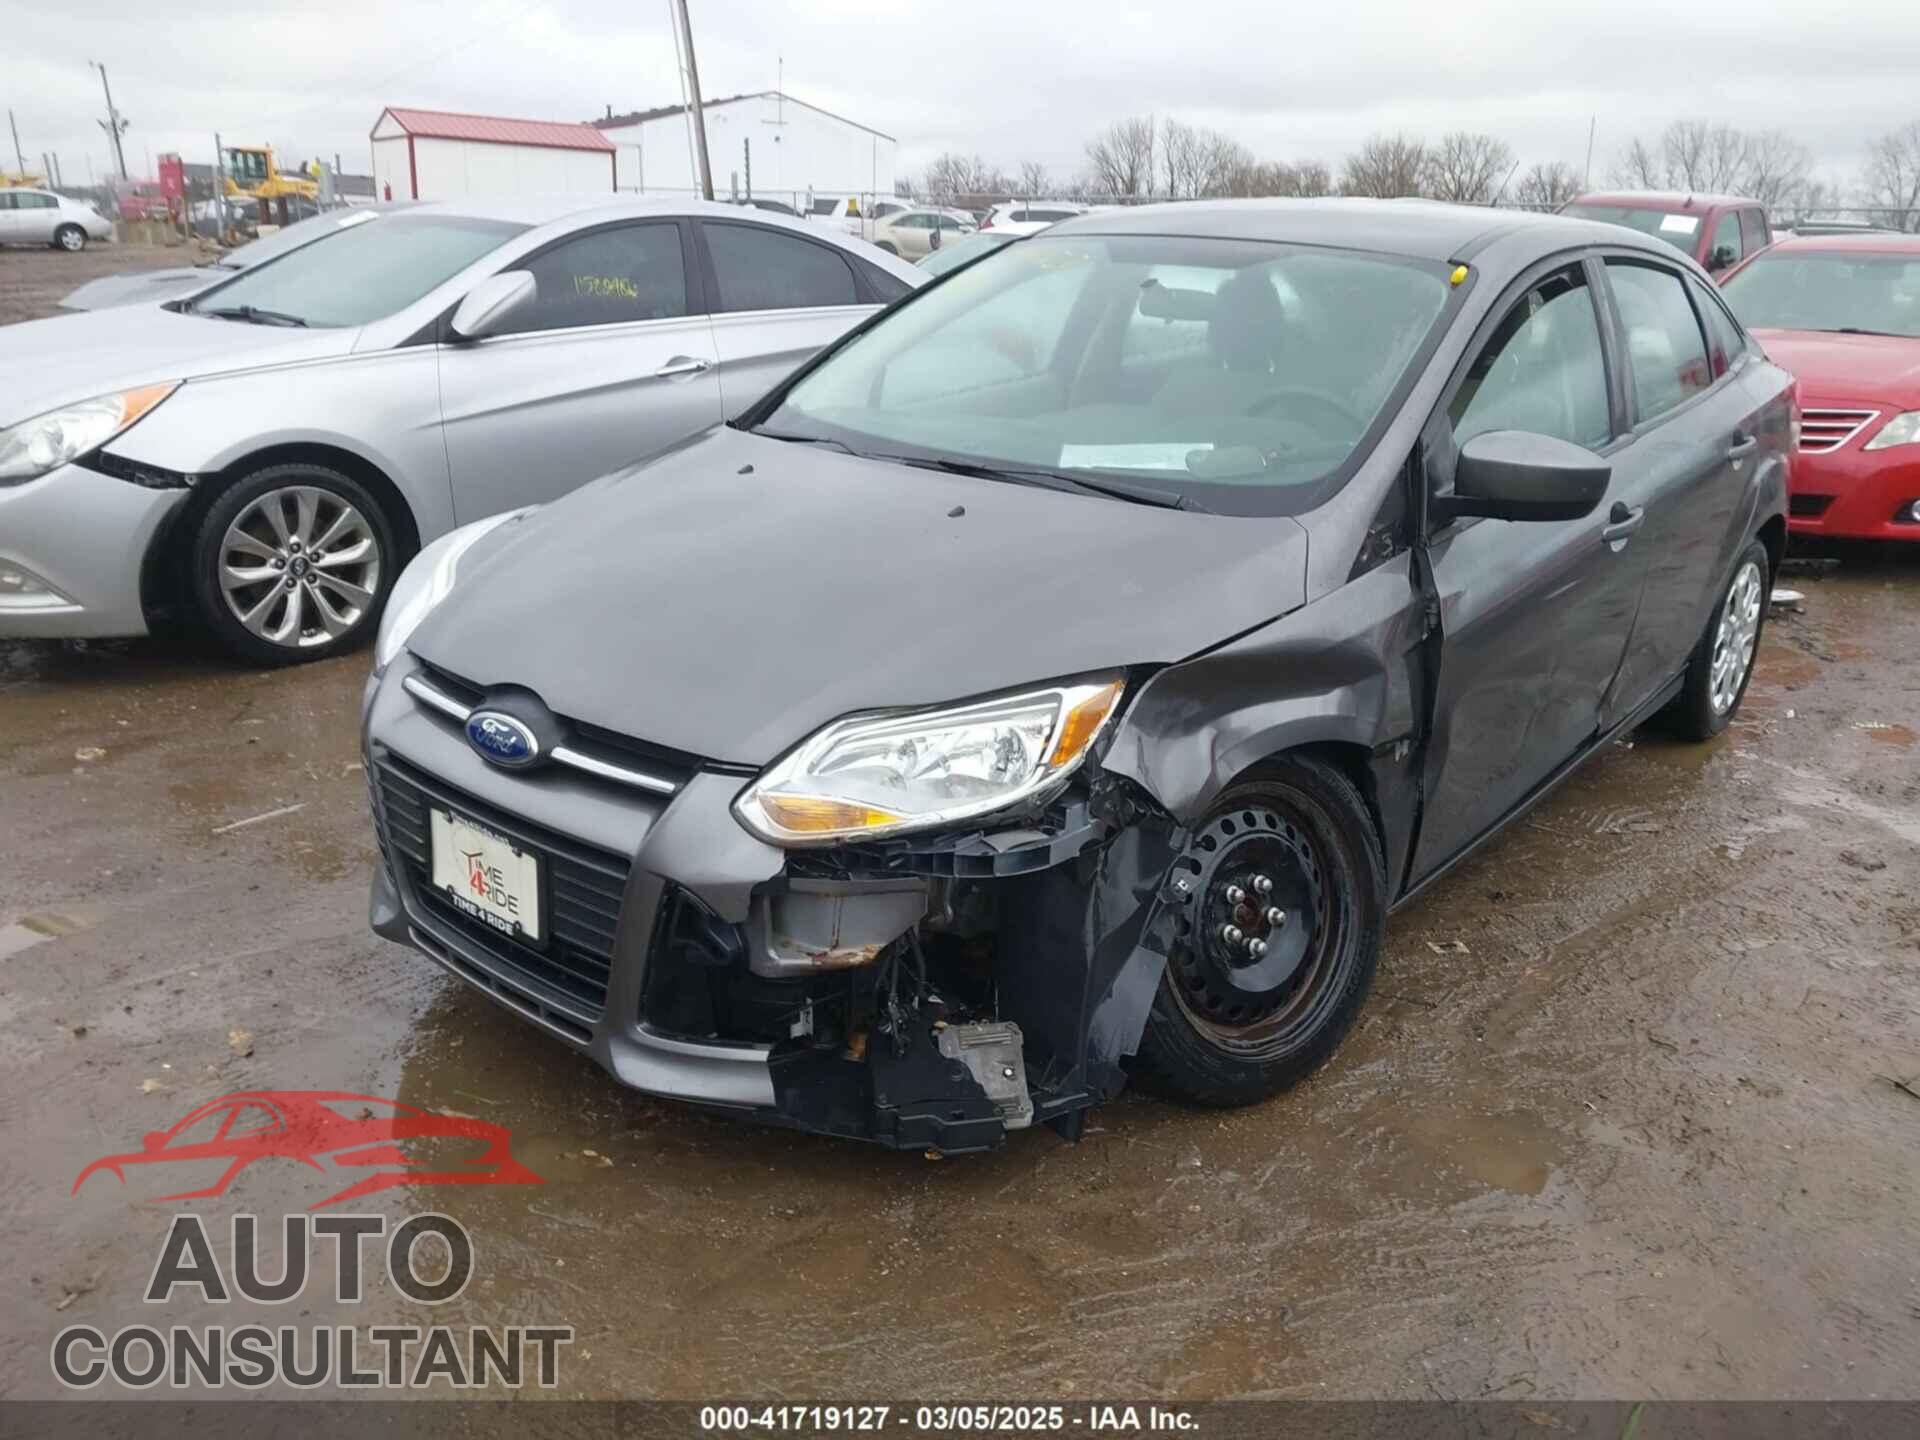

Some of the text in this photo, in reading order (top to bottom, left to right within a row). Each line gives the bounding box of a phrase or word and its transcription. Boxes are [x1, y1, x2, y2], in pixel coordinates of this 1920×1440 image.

[476, 718, 517, 753] Ford
[460, 850, 504, 889] TIME
[470, 870, 486, 896] 4
[453, 895, 477, 917] TIME
[487, 913, 513, 936] RIDE
[481, 881, 519, 915] RIDE
